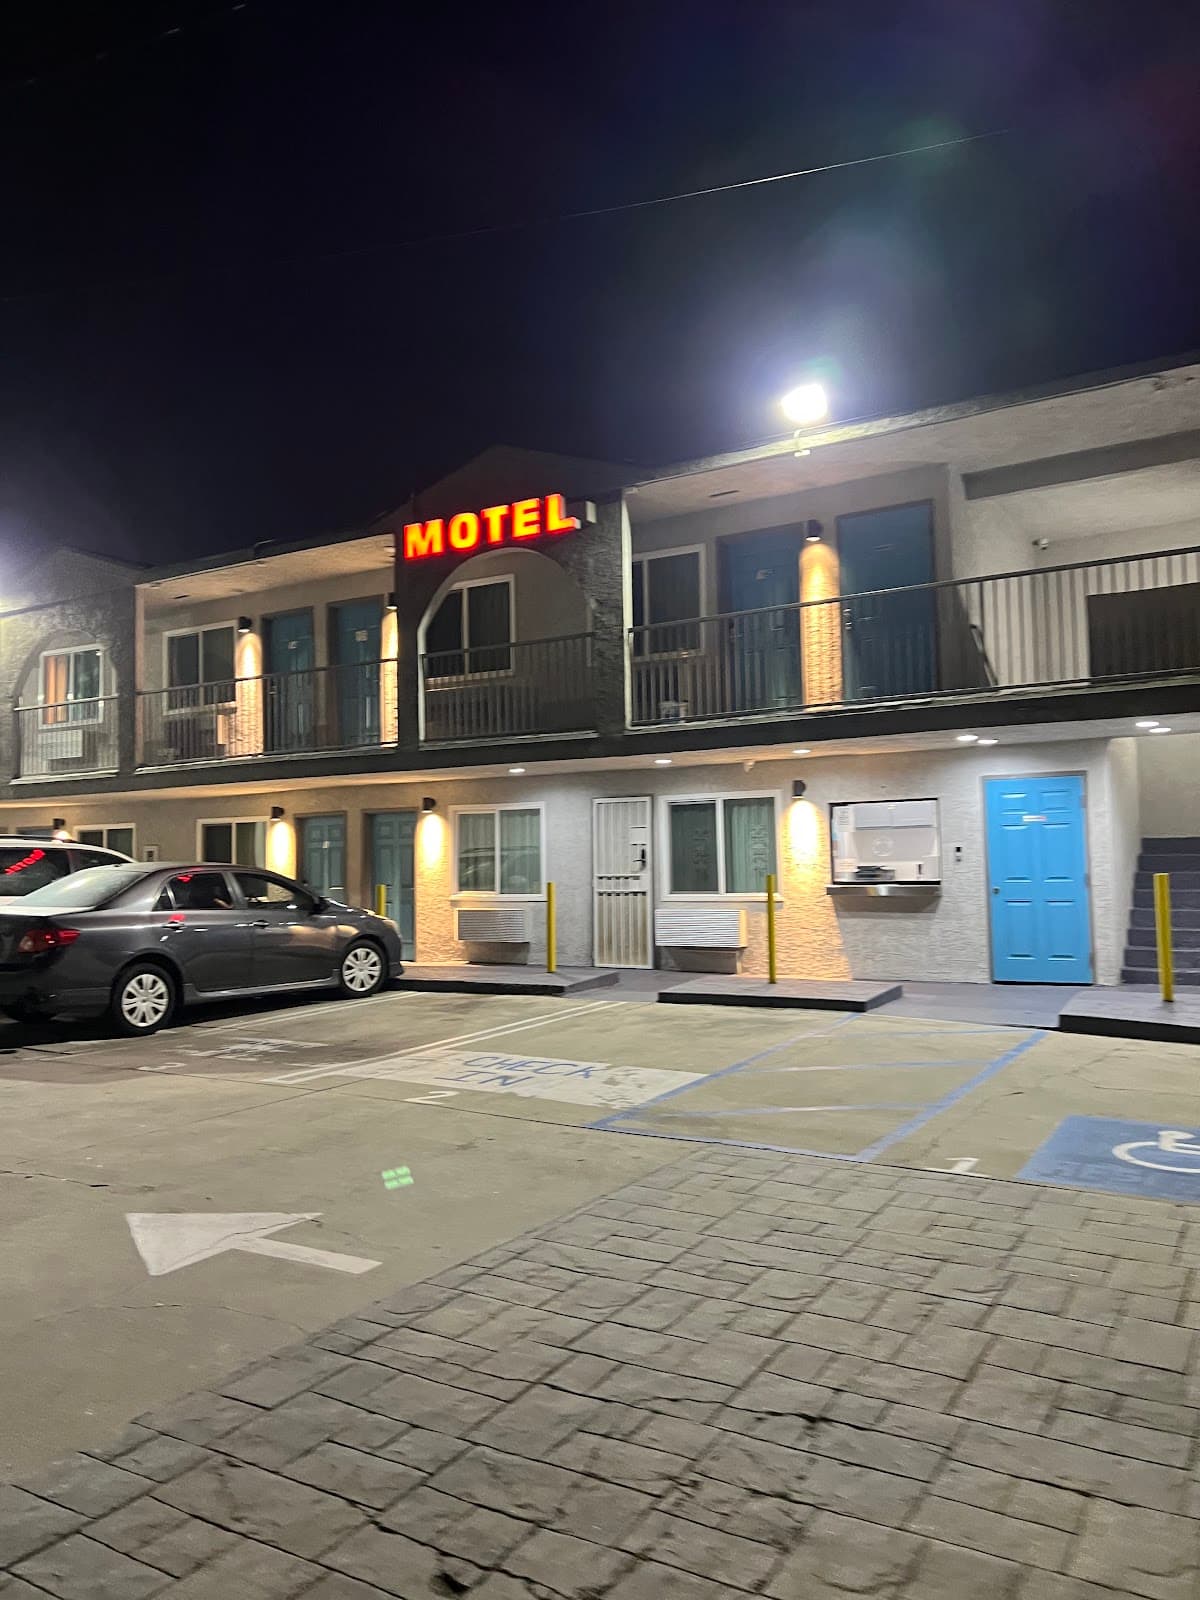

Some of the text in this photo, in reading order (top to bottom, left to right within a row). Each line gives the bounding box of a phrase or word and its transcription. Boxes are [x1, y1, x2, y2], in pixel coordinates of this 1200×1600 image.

[403, 493, 577, 560] MOTEL
[464, 1056, 606, 1079] CHECK
[434, 1071, 534, 1087] IN
[404, 1090, 460, 1105] 2
[924, 1157, 988, 1177] 1
